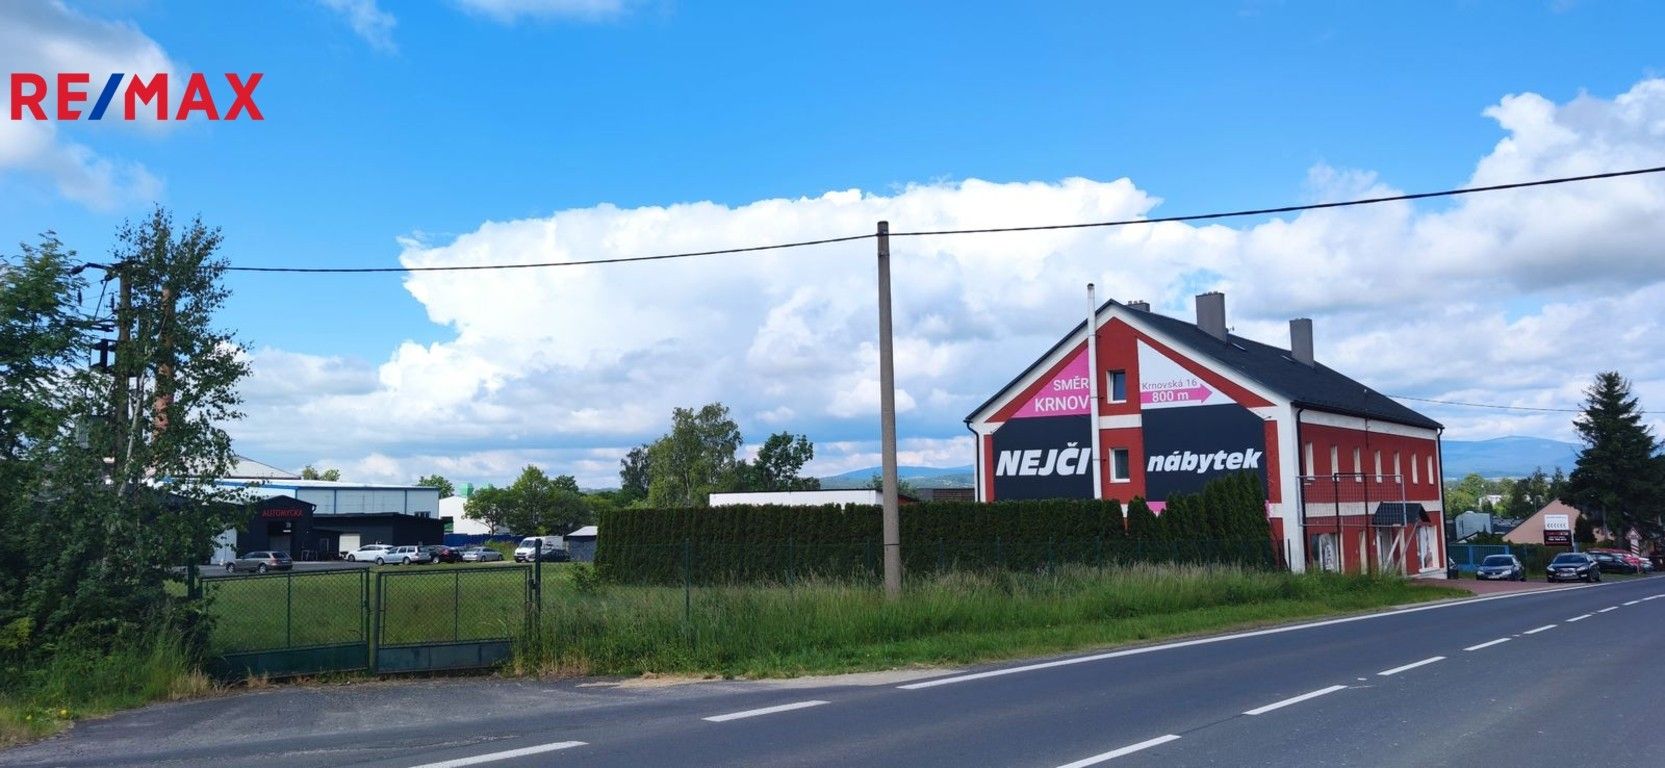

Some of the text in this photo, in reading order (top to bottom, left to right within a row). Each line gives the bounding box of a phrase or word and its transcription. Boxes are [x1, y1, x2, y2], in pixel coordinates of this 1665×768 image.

[1053, 376, 1089, 391] SMĚR
[1141, 378, 1198, 391] Krnovská 16
[1035, 395, 1089, 412] KRNOV
[1152, 391, 1189, 402] 800 m
[996, 441, 1092, 475] NEJČI
[1147, 448, 1263, 474] nábytek
